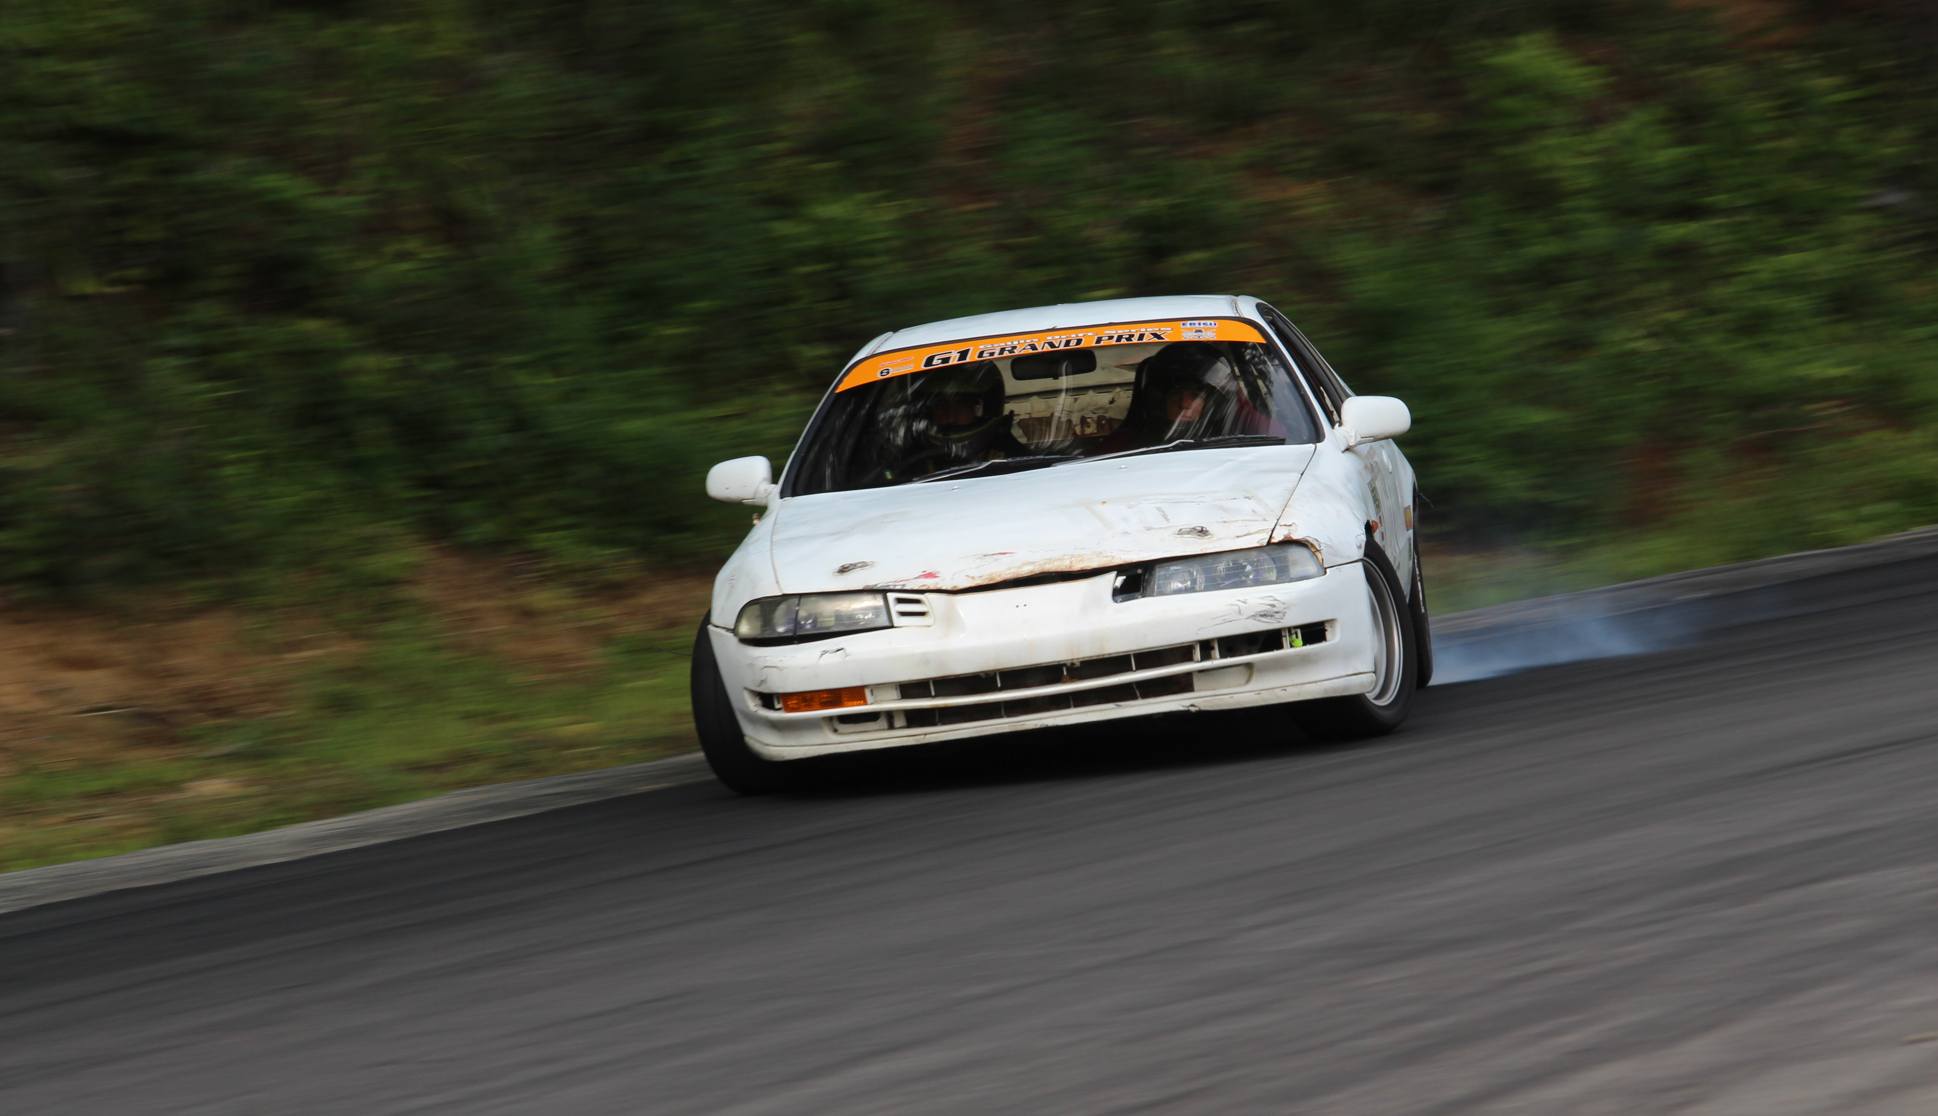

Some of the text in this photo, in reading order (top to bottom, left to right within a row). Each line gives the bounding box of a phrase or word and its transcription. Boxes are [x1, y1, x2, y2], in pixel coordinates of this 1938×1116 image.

[922, 347, 972, 369] G1
[976, 338, 1084, 360] GRAND
[1093, 331, 1168, 346] PRIX
